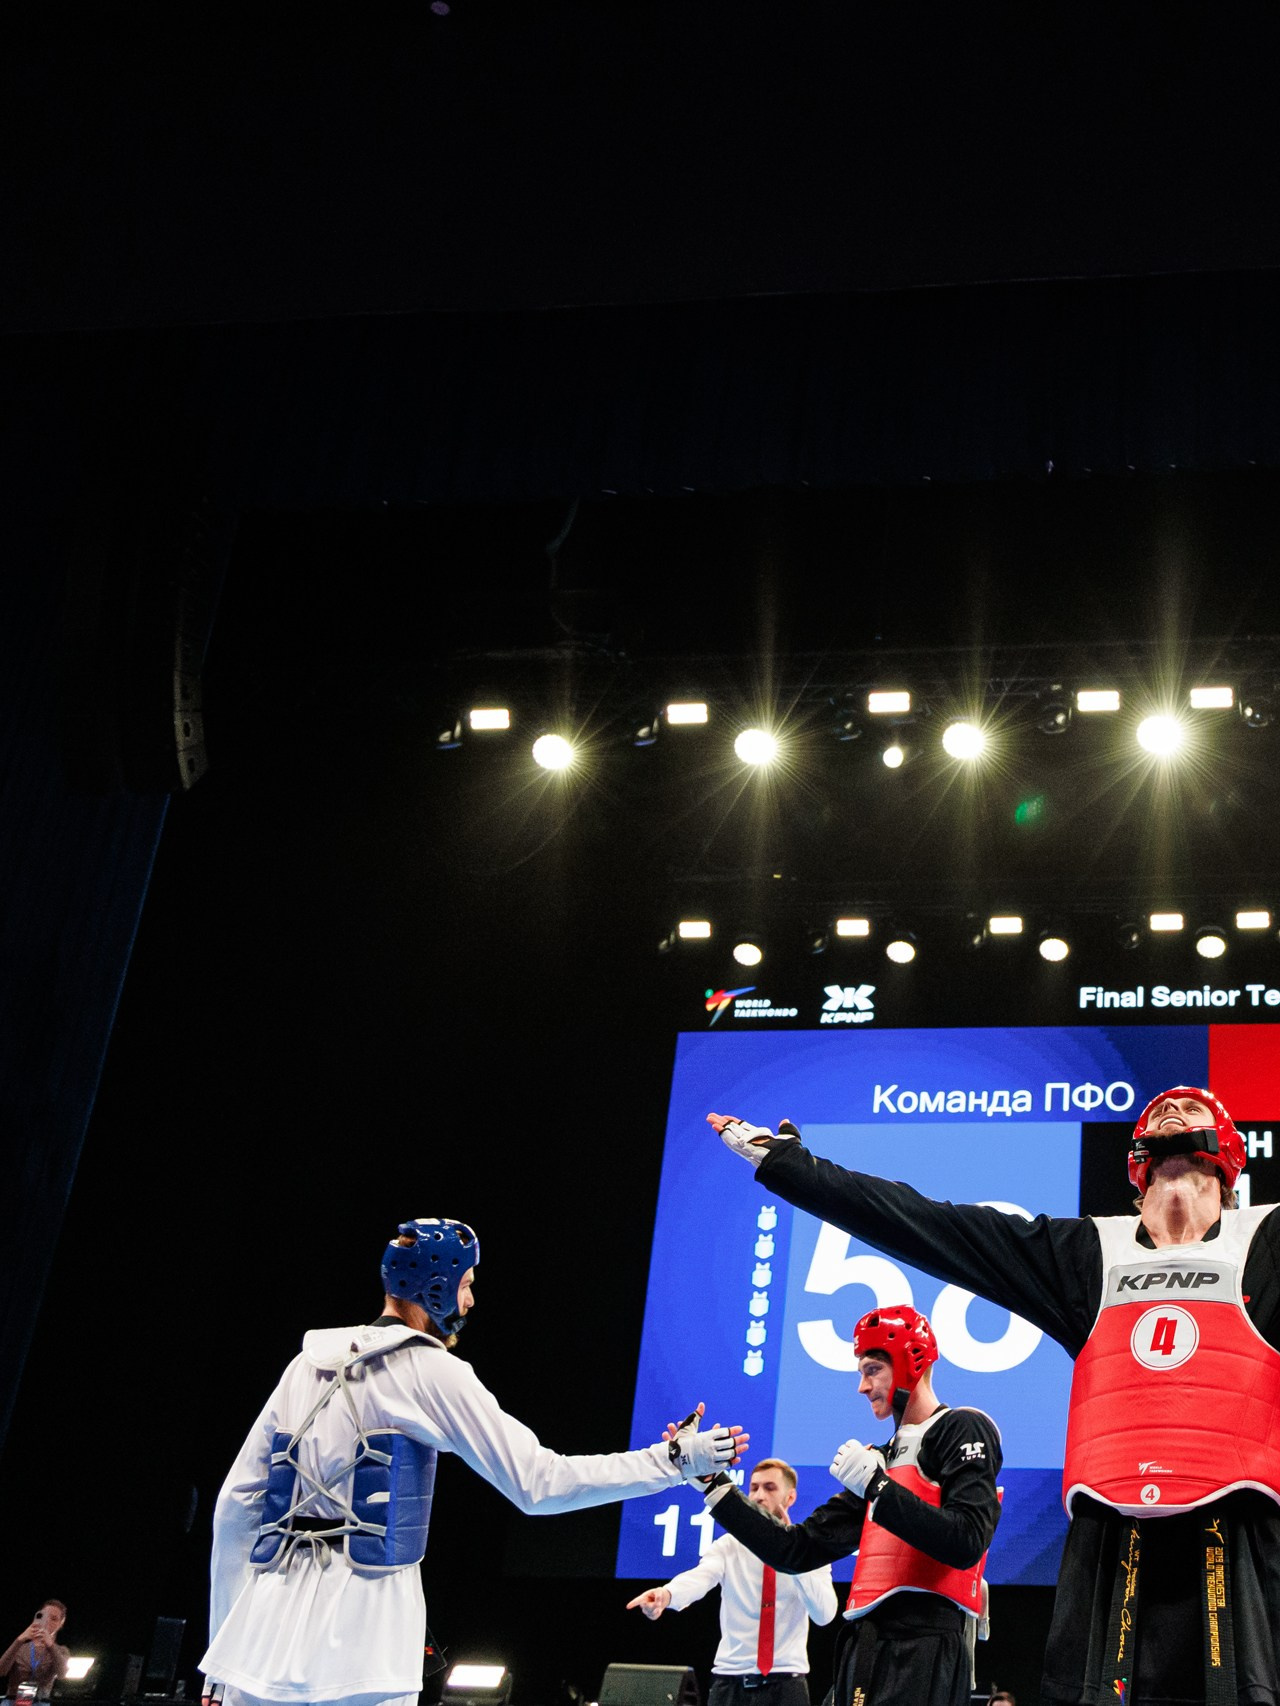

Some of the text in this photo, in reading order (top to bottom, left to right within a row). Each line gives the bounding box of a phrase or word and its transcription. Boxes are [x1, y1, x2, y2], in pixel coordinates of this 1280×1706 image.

[734, 999, 771, 1008] WORLD
[1079, 986, 1144, 1008] Final
[1151, 984, 1241, 1007] Senior
[734, 1009, 798, 1018] TAEKWONDO
[820, 1012, 874, 1024] KPNP
[872, 1081, 1135, 1117] Команда ПФО
[1116, 1271, 1220, 1293] KPNP
[1150, 1317, 1178, 1356] 4
[1215, 1565, 1226, 1607] MANCHESTER
[1206, 1547, 1221, 1667] WORLD TAEKWONDO CHAMPIONSHIPS
